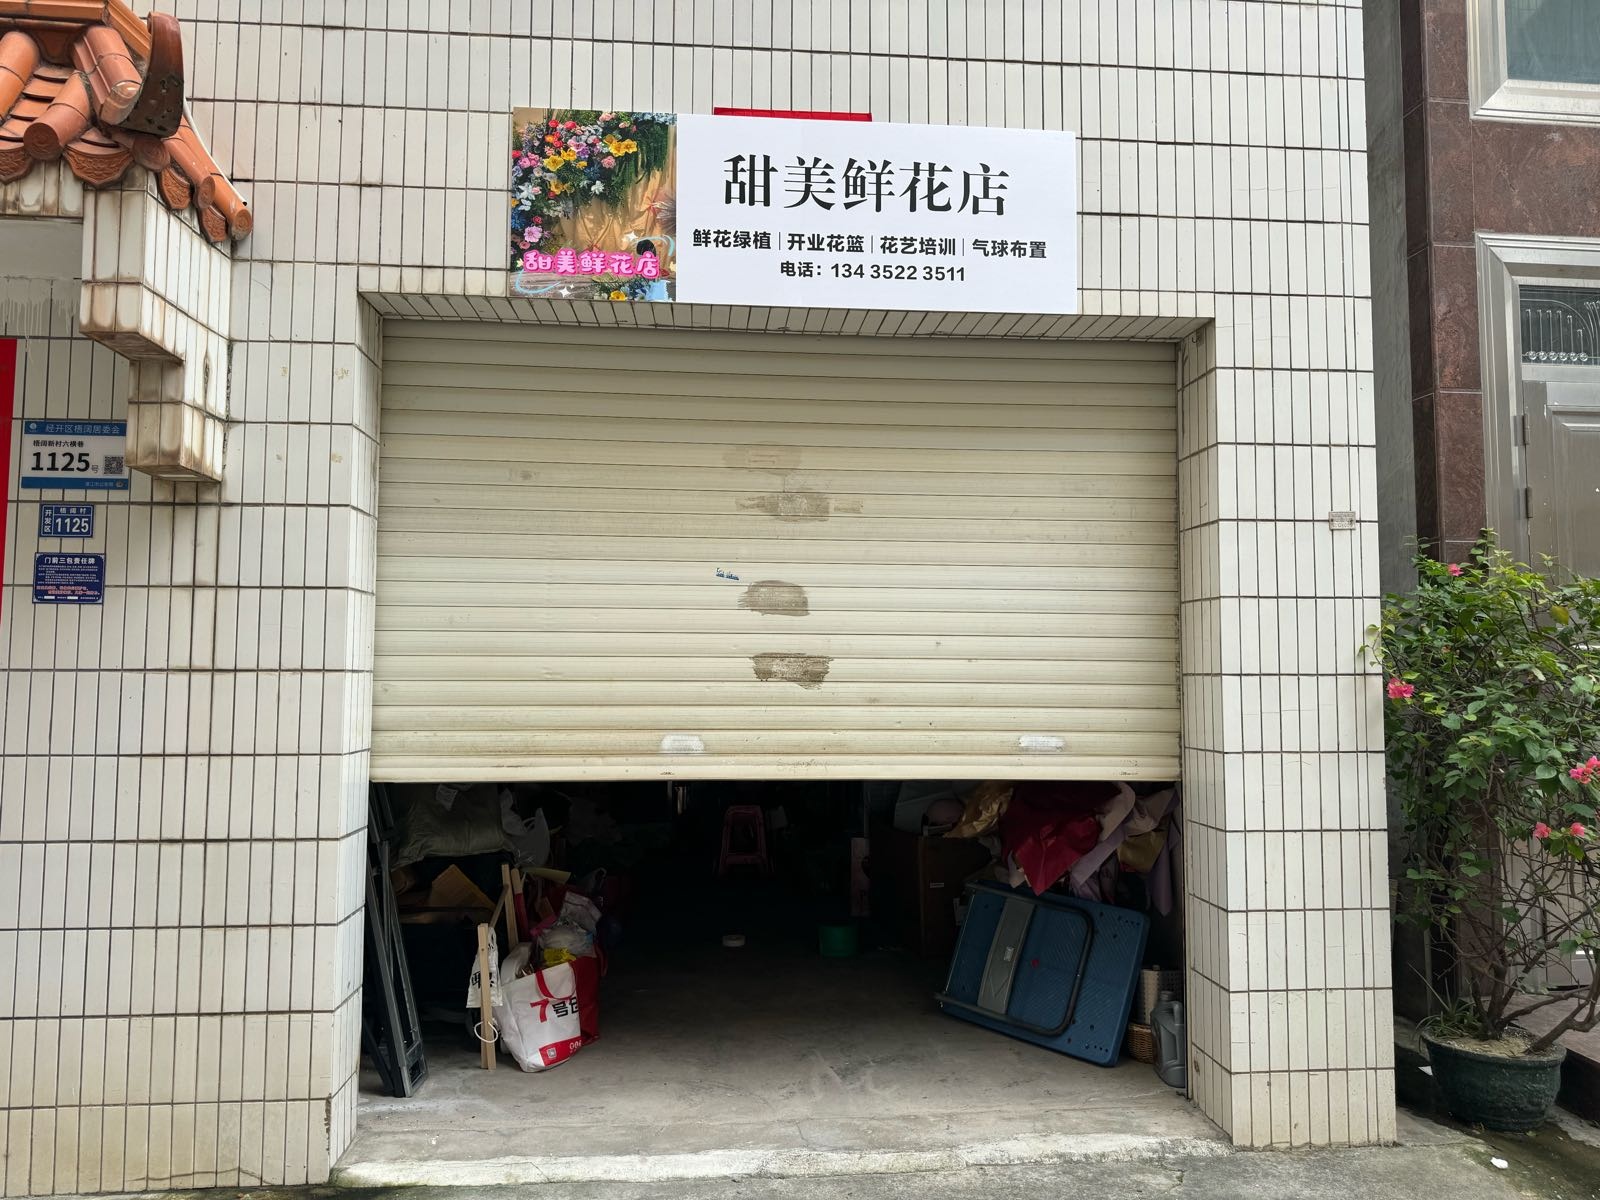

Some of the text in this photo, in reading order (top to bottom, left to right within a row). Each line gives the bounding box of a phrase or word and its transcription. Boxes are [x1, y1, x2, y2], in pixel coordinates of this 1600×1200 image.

[723, 154, 1010, 216] 甜美鲜花店
[692, 228, 1047, 259] 鲜花绿植 开业花篮 花艺培训 气球布置
[523, 249, 660, 279] 甜美鲜花店
[830, 263, 865, 279] 134
[870, 264, 918, 280] 3522
[922, 265, 965, 282] 3511
[44, 510, 52, 533] 开发区
[55, 517, 89, 533] 1125
